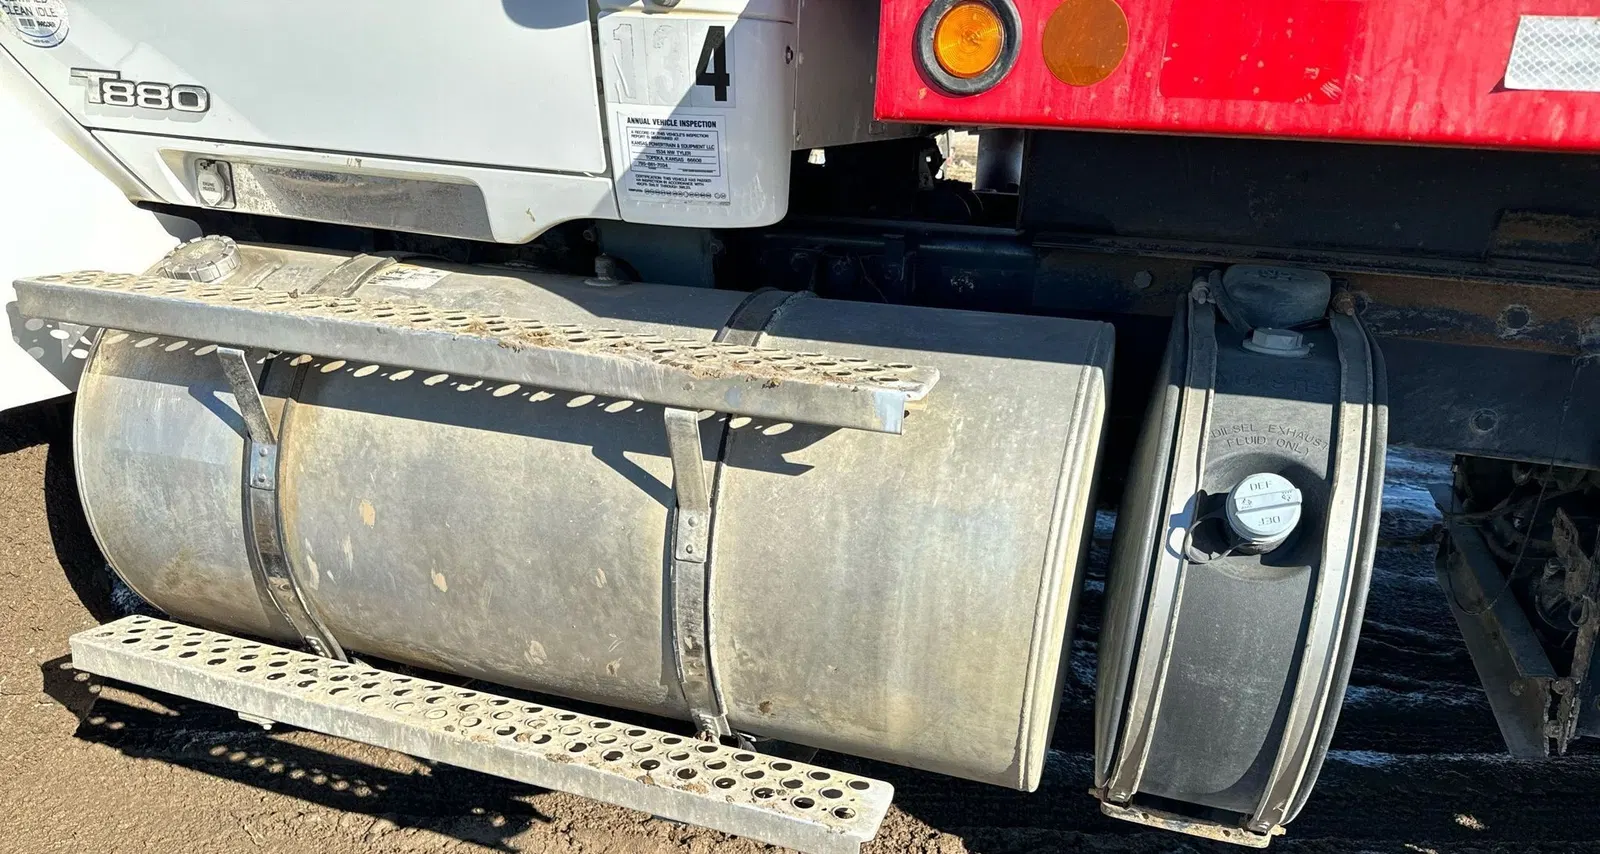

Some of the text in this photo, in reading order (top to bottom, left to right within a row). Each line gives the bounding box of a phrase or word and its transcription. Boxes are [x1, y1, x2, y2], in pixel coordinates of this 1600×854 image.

[2, 4, 58, 18] CLEAN IDLE
[70, 67, 210, 113] T880
[627, 117, 717, 128] ANNUAL VEHICLE INSPECTION
[1211, 423, 1257, 439] DIESEL
[1226, 436, 1267, 448] FLUID
[1249, 481, 1273, 491] DEF
